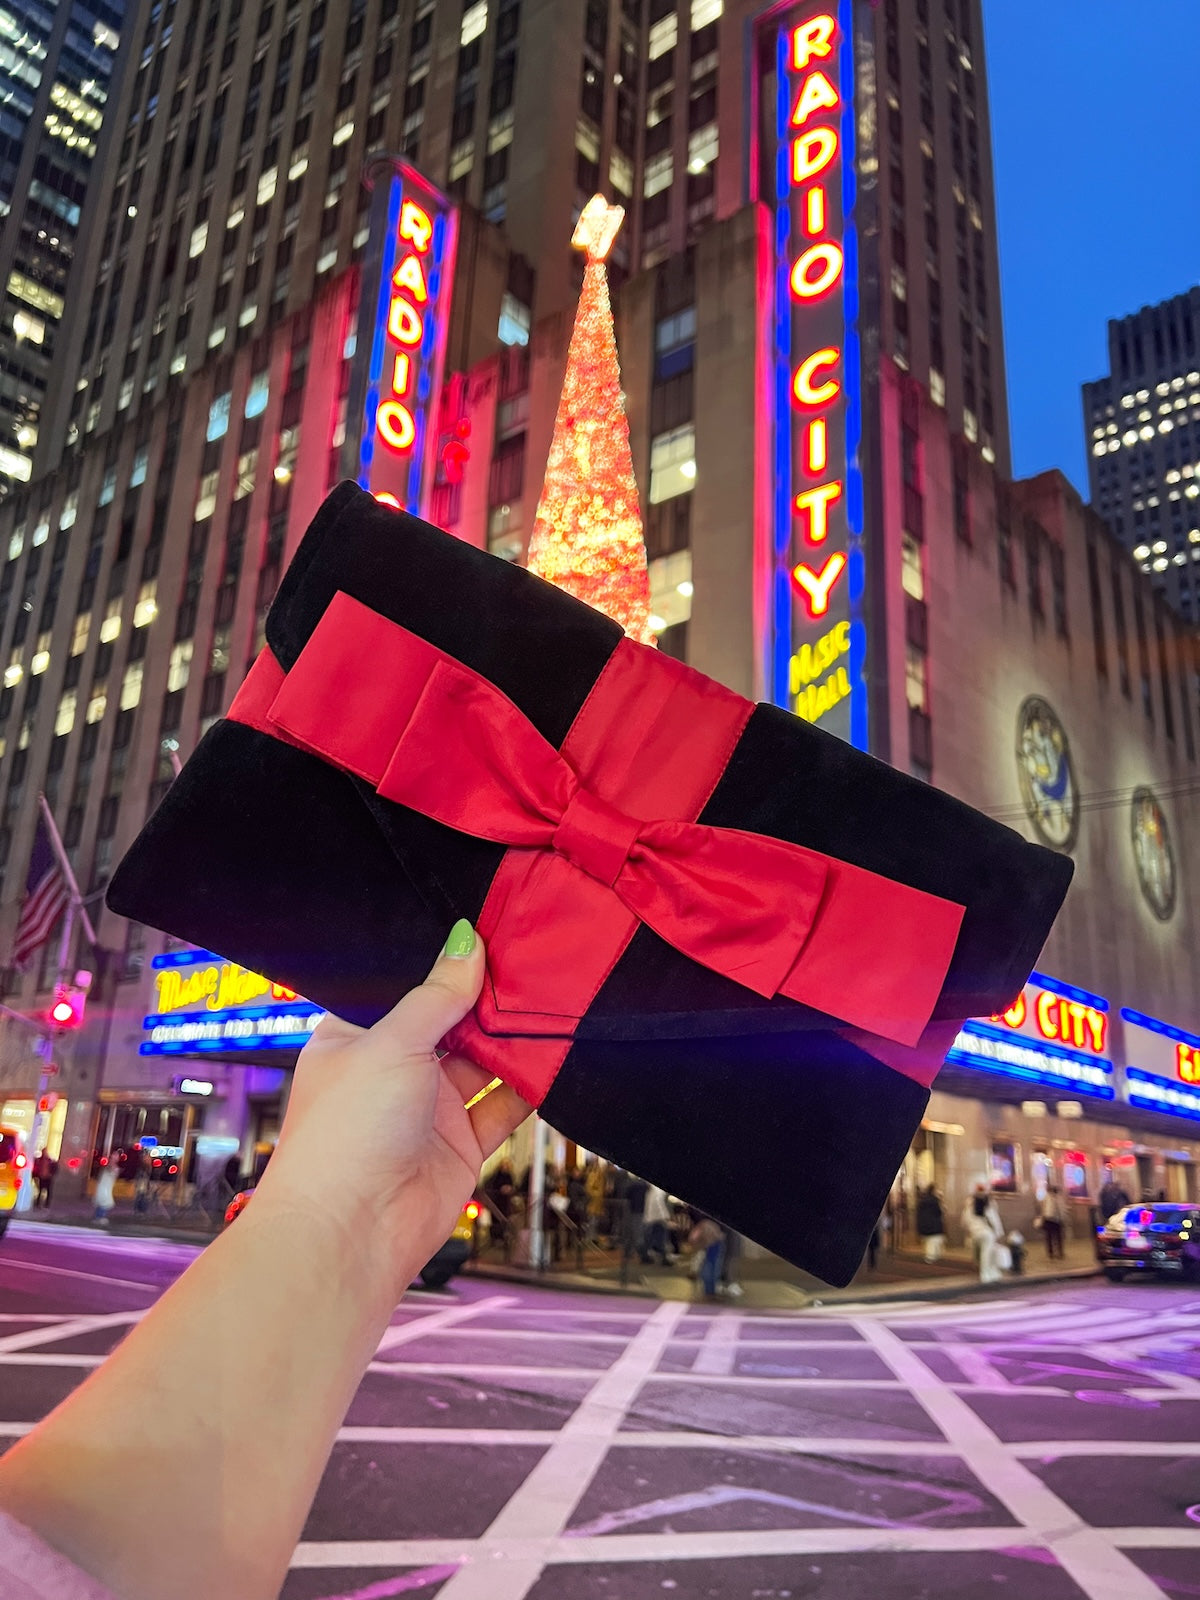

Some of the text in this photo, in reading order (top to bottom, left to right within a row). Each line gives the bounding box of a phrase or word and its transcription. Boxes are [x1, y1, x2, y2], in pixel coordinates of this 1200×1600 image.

[376, 197, 432, 451] RADIO
[790, 14, 847, 619] RADIO CITY
[1036, 990, 1107, 1053] CITY
